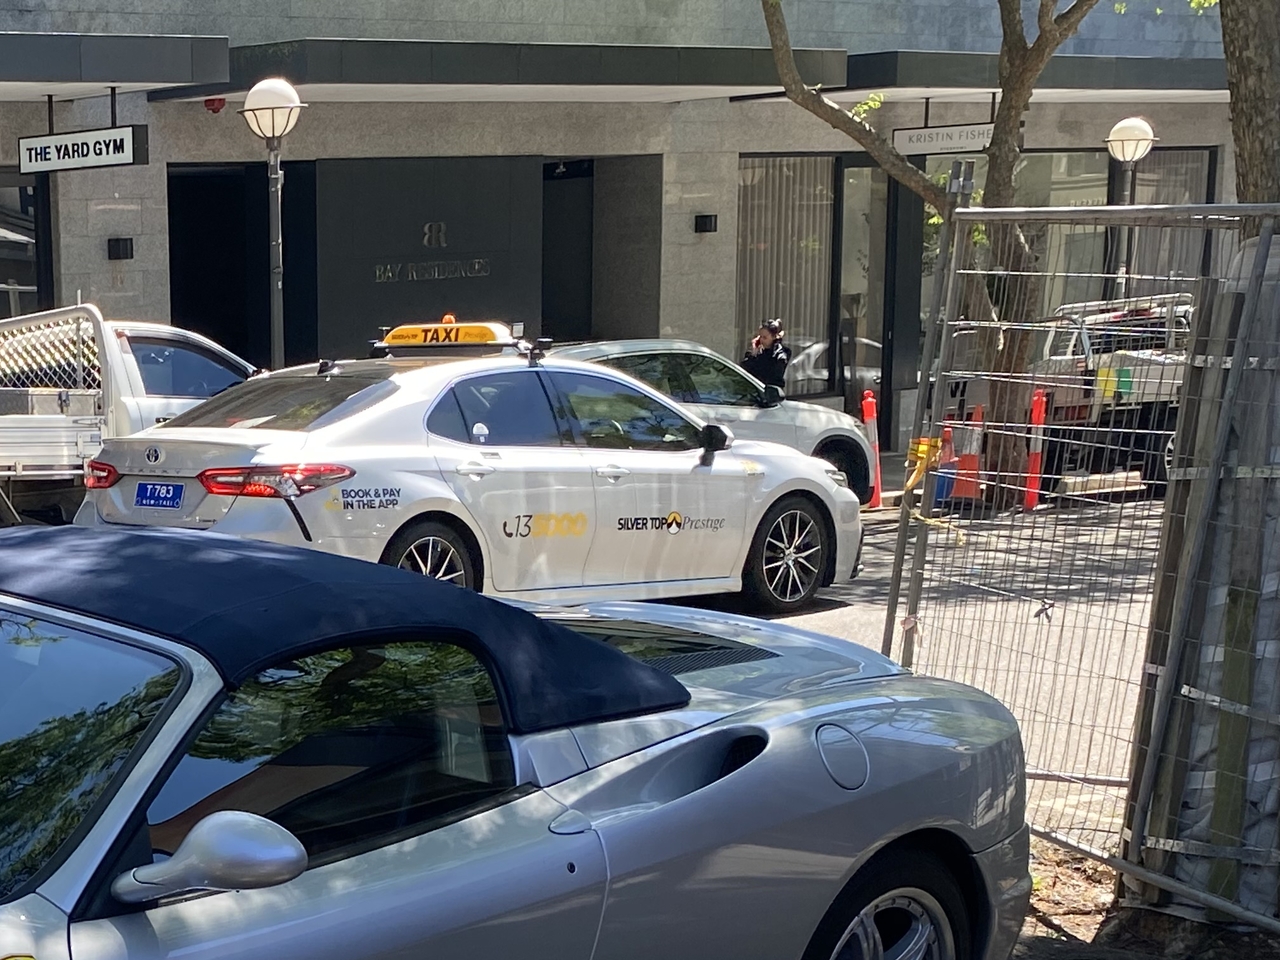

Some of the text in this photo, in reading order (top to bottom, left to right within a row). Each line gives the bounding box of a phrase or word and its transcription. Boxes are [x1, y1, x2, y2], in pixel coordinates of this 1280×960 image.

[908, 129, 992, 144] KRISTIN FISHE
[26, 138, 125, 163] THE YARD GYM
[375, 258, 491, 283] BAY RESIDENCES
[422, 327, 460, 343] TAXI
[341, 488, 401, 499] BOOK & PAY
[343, 499, 398, 510] IN THE APP
[617, 516, 725, 533] SILVER TOP Prestige
